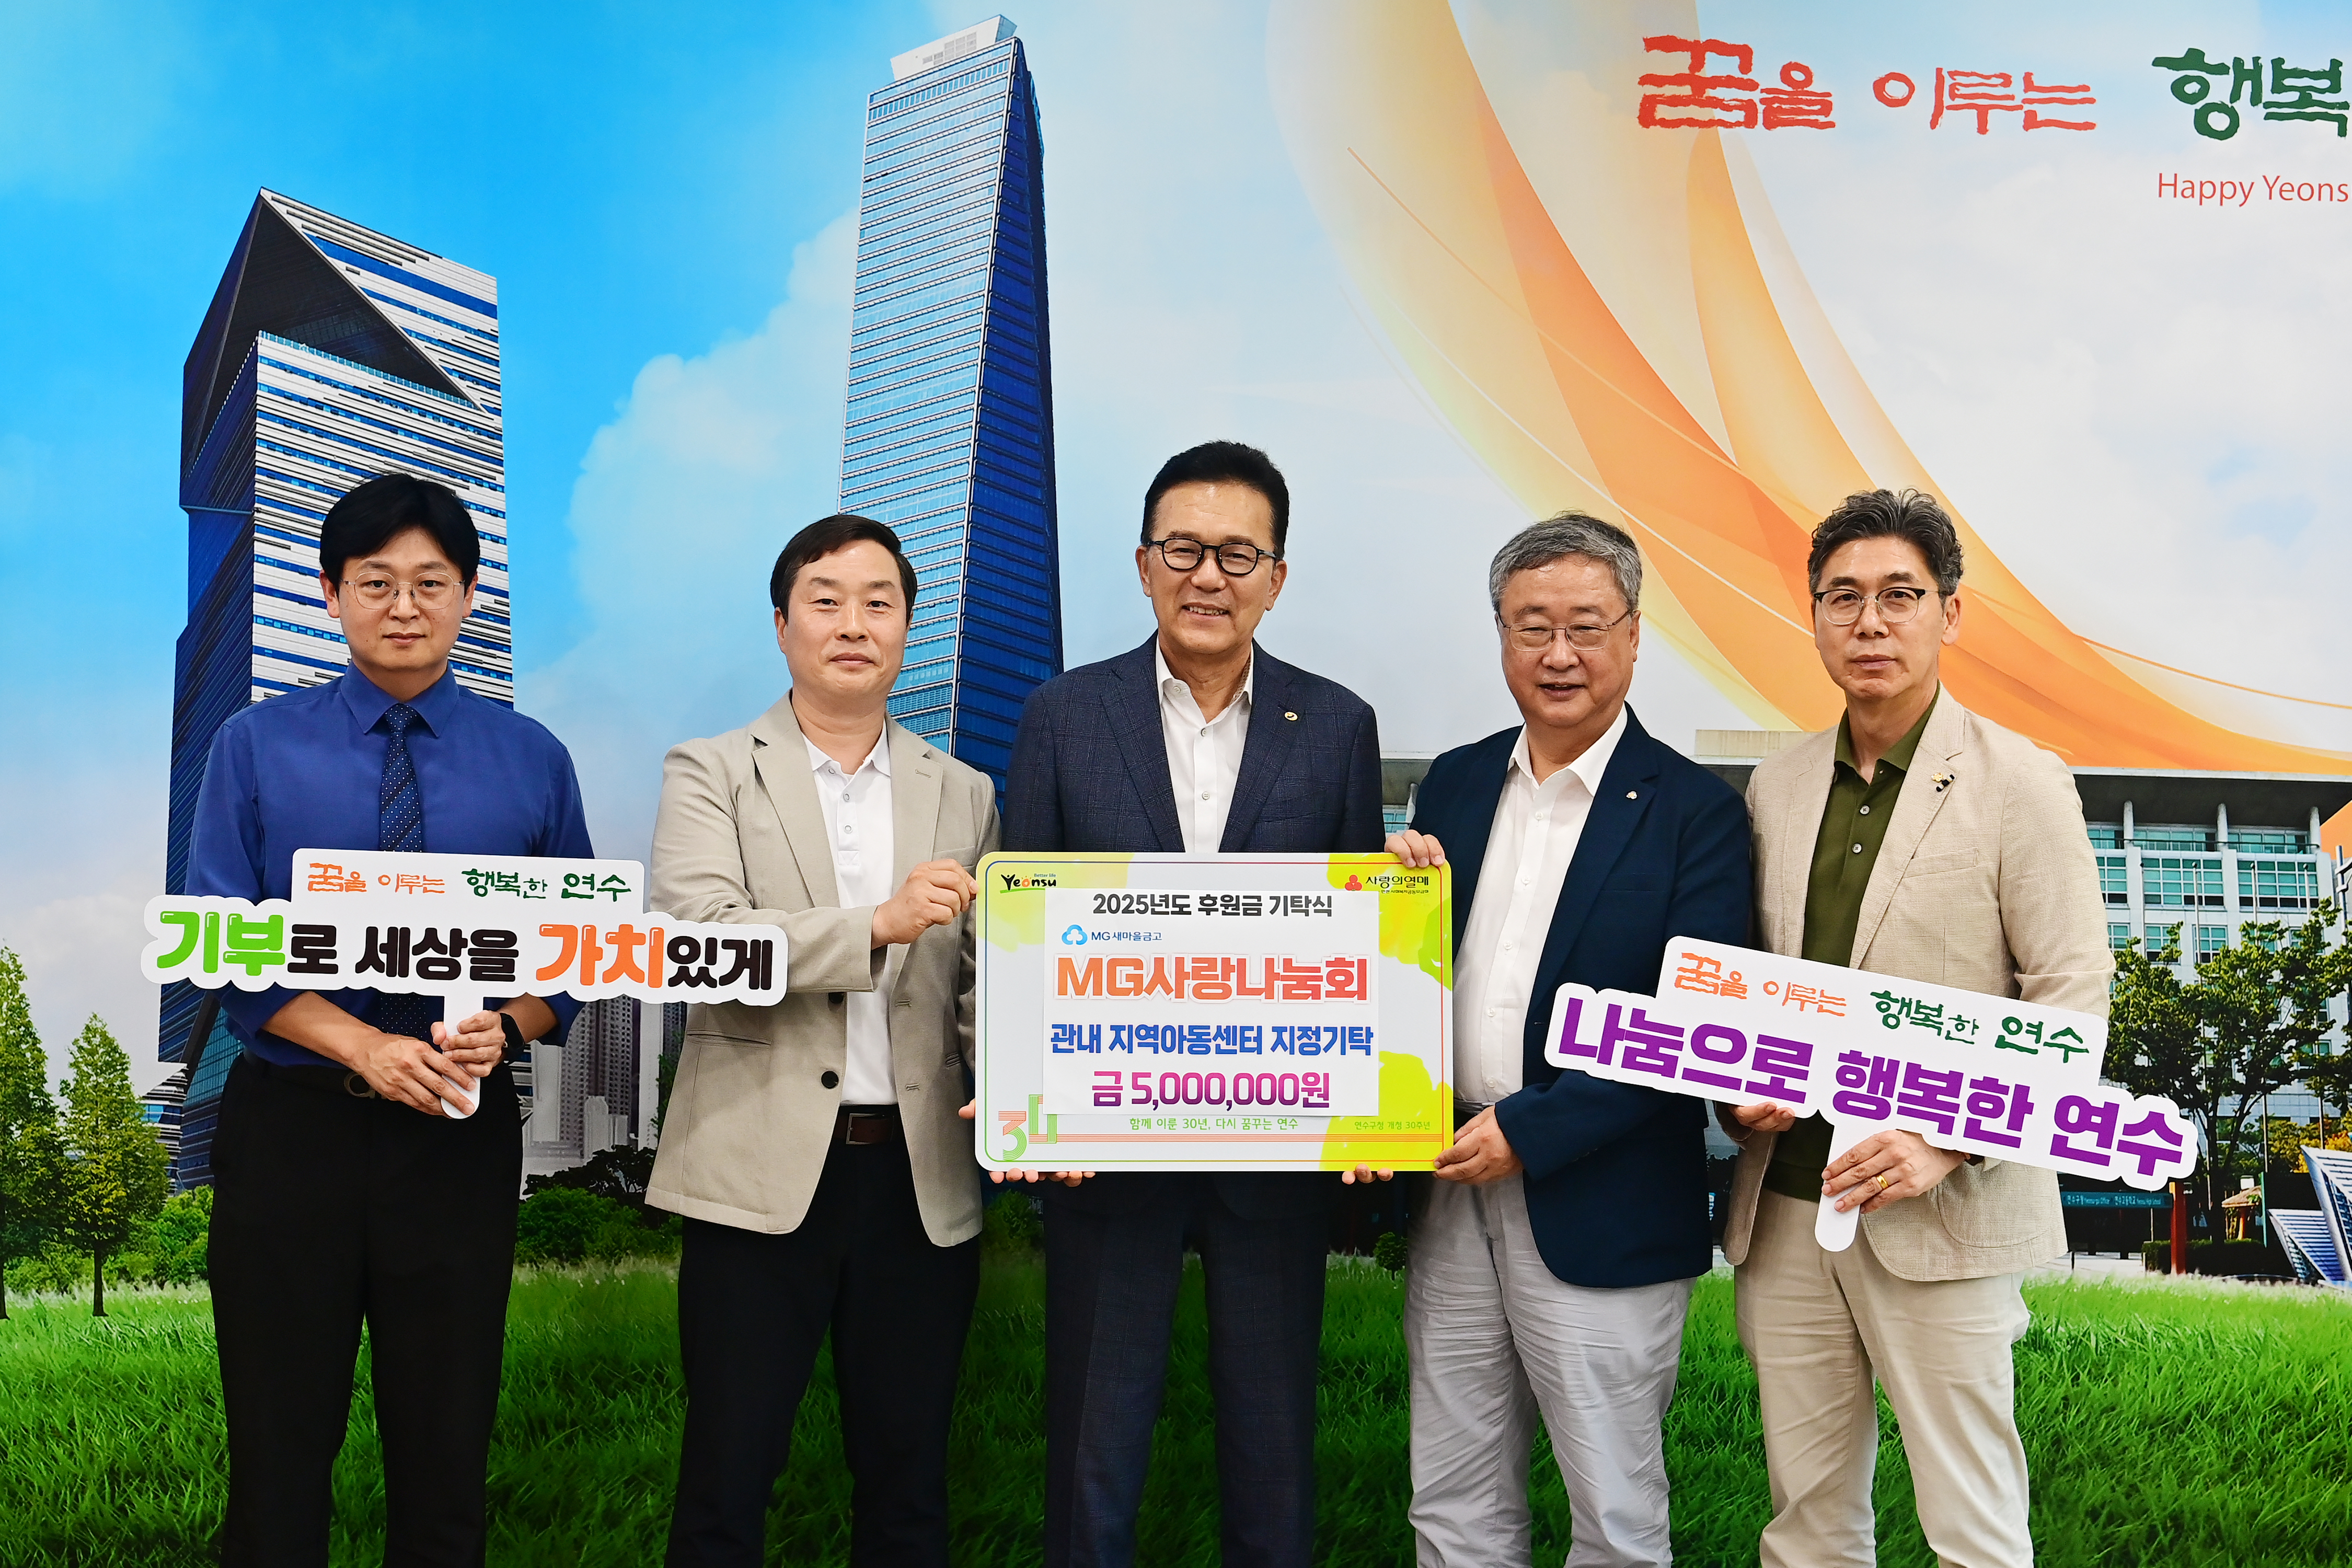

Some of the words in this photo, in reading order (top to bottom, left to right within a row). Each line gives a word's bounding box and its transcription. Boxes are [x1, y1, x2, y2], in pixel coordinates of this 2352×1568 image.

[1637, 35, 1836, 131] 꿈을
[1873, 67, 2096, 135] 이루는
[2152, 48, 2350, 141] 행복
[2159, 172, 2255, 207] Happy
[2262, 175, 2348, 202] Yeons
[308, 862, 367, 893] 꿈을
[378, 873, 445, 895] 이루는
[461, 868, 548, 899] 행복한
[561, 872, 631, 902] 연수
[1000, 874, 1056, 891] Yeonsu
[1365, 876, 1429, 889] 사랑의열매
[1093, 893, 1192, 915] 2025년도
[1197, 894, 1263, 916] 후원금
[1269, 895, 1332, 917] 기탁식
[156, 910, 339, 976] 기부로
[355, 926, 519, 982] 세상을
[536, 923, 773, 990] 가치있게
[1091, 931, 1111, 941] MG
[1112, 931, 1162, 941] 새마을금고
[1056, 956, 1368, 1001] MG사랑나눔회
[1675, 952, 1748, 999] 꿈을
[1763, 981, 1847, 1017] 이루는
[1871, 990, 1979, 1045] 행복한
[1994, 1016, 2089, 1063] 연수
[1051, 1024, 1102, 1054] 관내
[1108, 1024, 1263, 1055] 지역아동센터
[1270, 1025, 1374, 1056] 지정기탁
[1092, 1071, 1123, 1107] 금
[1131, 1072, 1330, 1111] 5,000,000원
[1559, 997, 1814, 1104] 나눔으로
[1832, 1050, 2034, 1149] 행복한
[2049, 1095, 2183, 1176] 연수
[1130, 1118, 1151, 1130] 함께
[1157, 1118, 1178, 1130] 이룬
[1182, 1118, 1210, 1130] 30년,
[1216, 1118, 1236, 1129] 다시
[1241, 1118, 1273, 1130] 꿈꾸는
[1277, 1118, 1298, 1130] 연수
[1354, 1121, 1384, 1130] 연수구청
[1387, 1121, 1402, 1130] 개청
[1405, 1121, 1430, 1130] 30주년
